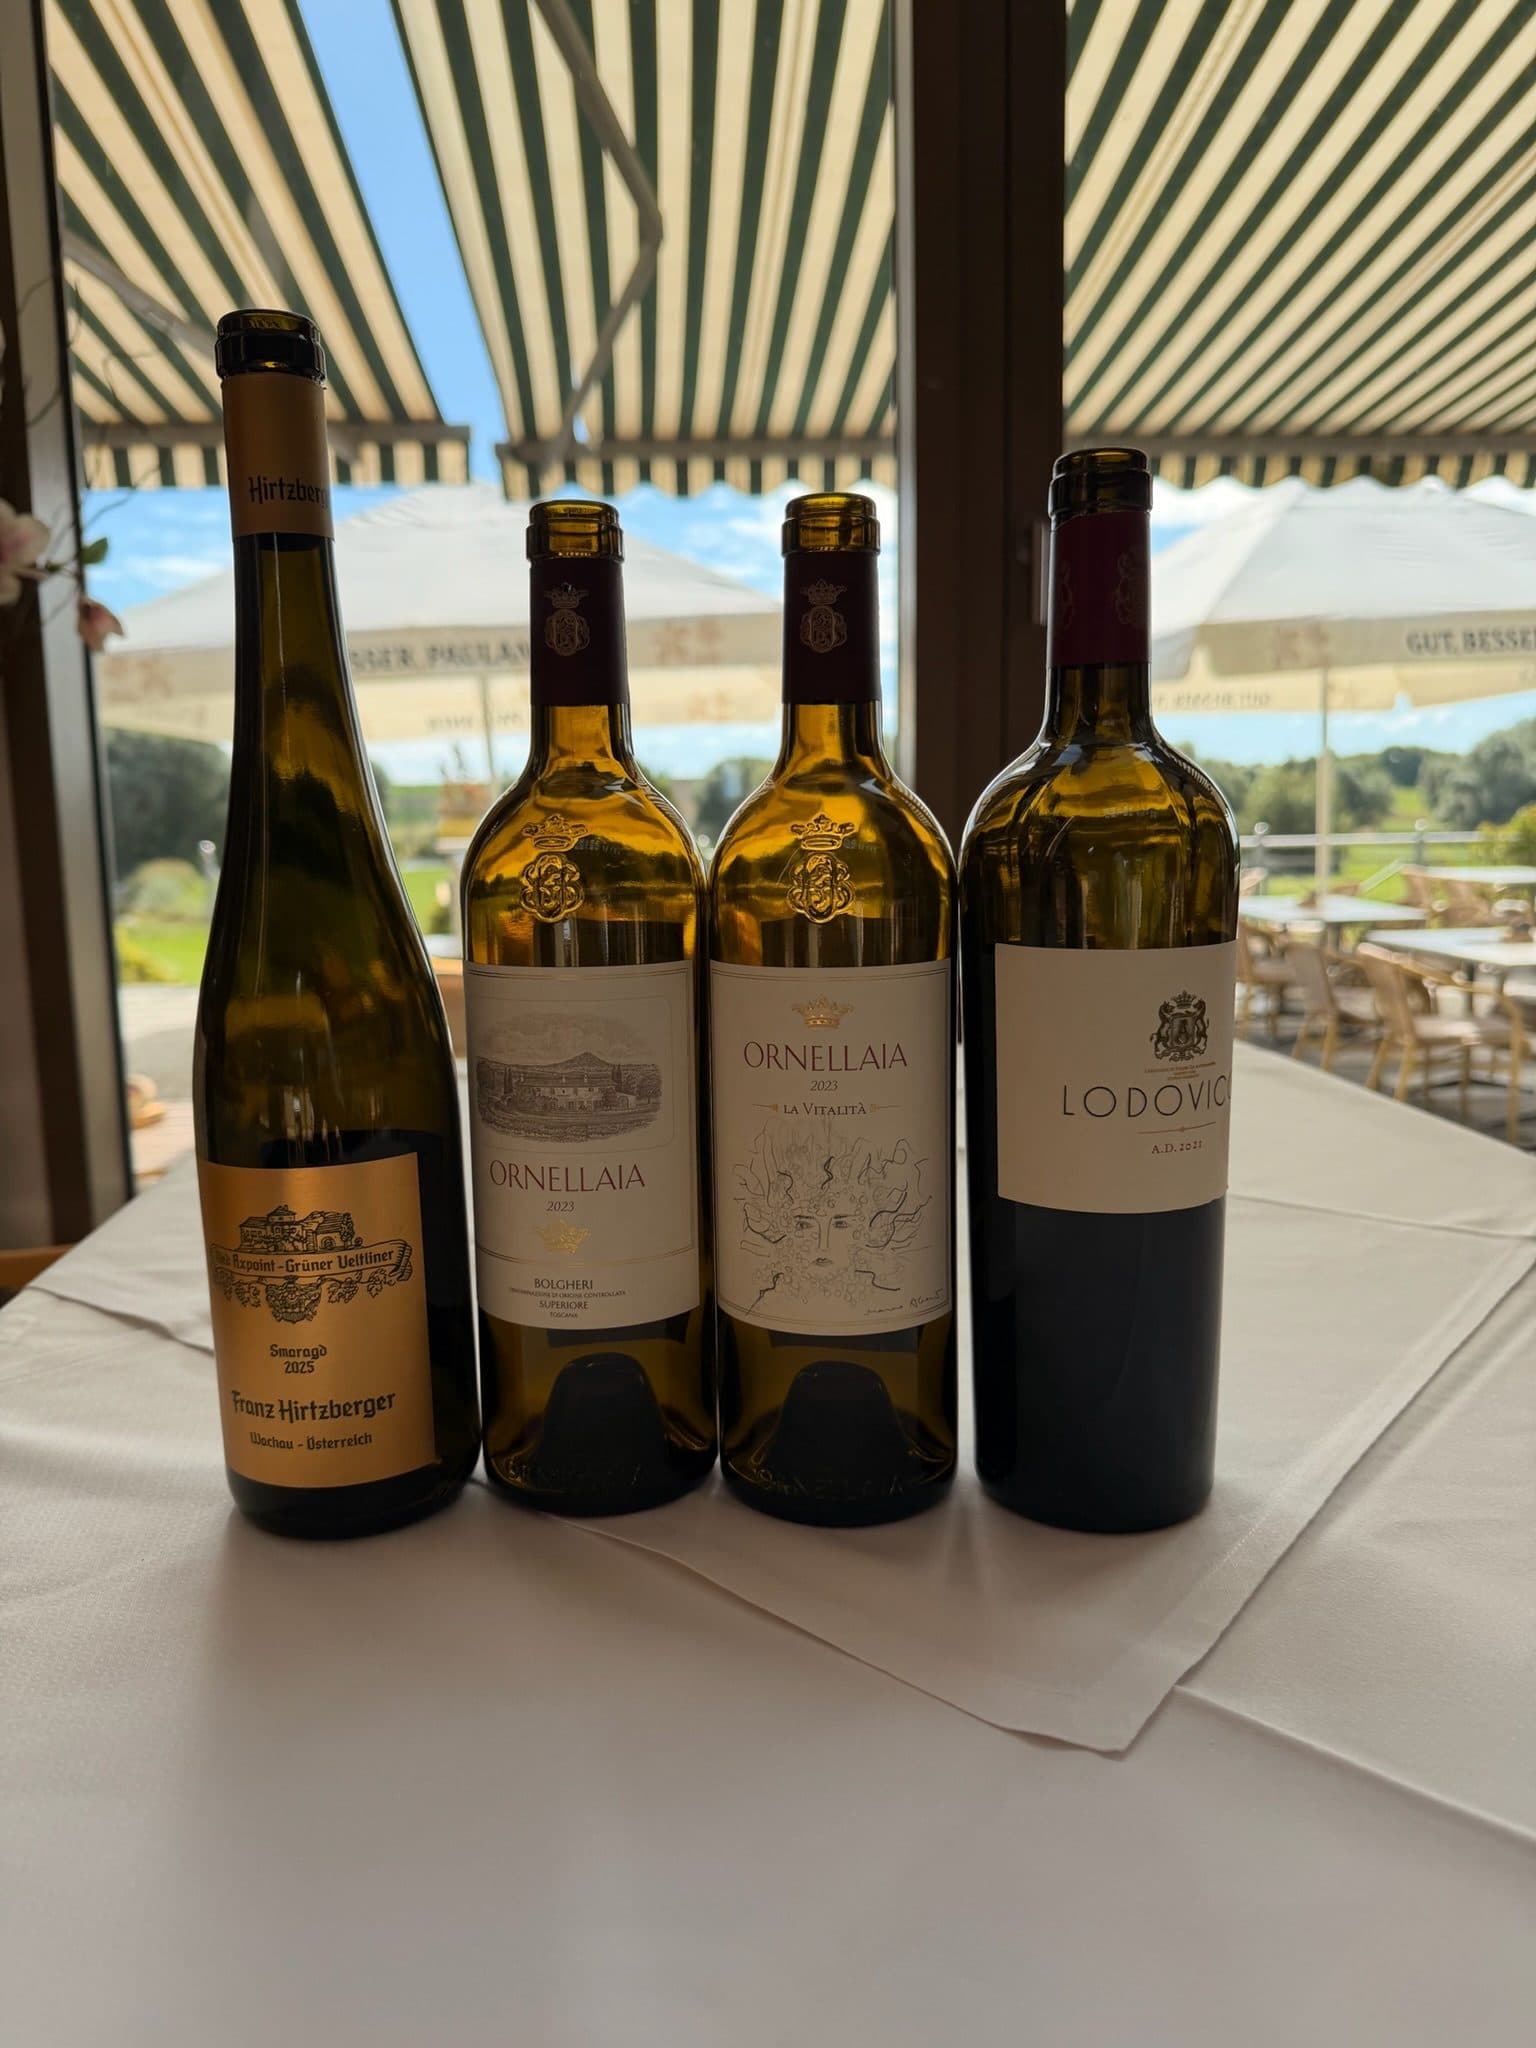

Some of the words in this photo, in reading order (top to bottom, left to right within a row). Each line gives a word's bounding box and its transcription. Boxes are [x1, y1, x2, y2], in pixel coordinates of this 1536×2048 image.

[744, 1041, 907, 1072] ORNELLAIA
[810, 1080, 838, 1092] 2023
[1063, 1072, 1231, 1118] LODOVIC
[784, 1104, 799, 1115] LA
[1151, 1142, 1177, 1155] A.D.
[489, 1159, 646, 1192] ORNELLAIA
[545, 1200, 575, 1213] 2023
[533, 1277, 594, 1291] BOLGHERI
[539, 1299, 589, 1310] SUPERIORE
[550, 1311, 578, 1319] TOSCANA
[269, 1343, 328, 1360] Smaragd
[283, 1360, 315, 1374] 2025
[231, 1389, 276, 1419] Franz
[278, 1393, 396, 1424] Hirtzberger
[249, 1431, 294, 1450] Wachau
[306, 1431, 373, 1451] Österreich
